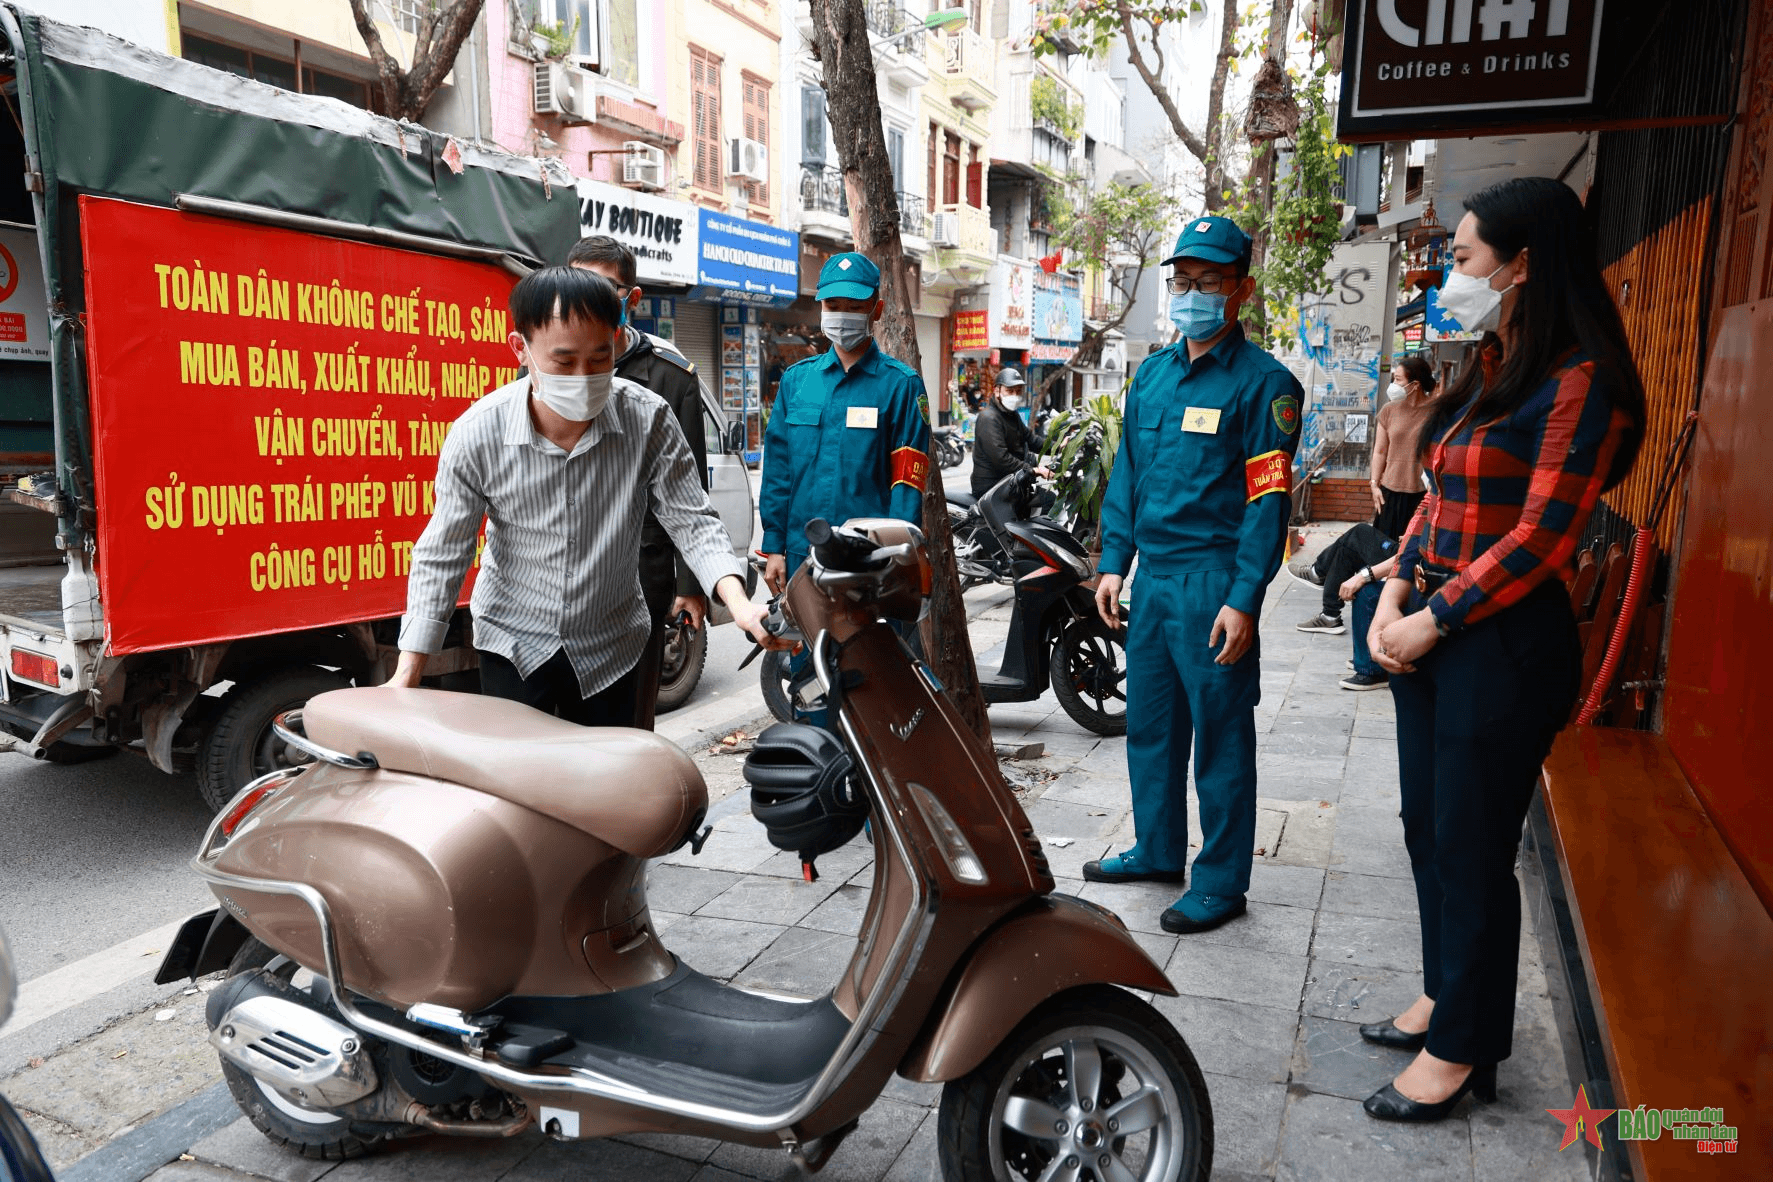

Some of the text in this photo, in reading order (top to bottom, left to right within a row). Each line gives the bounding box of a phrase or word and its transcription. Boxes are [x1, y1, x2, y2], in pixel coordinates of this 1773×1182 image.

[1377, 51, 1571, 81] Coffee & Drinks
[608, 204, 683, 245] BOUTIQUE
[703, 242, 729, 263] HANOI
[729, 247, 744, 266] OLD
[154, 259, 507, 346] TOÀN DÂN KHÔNG CHẾ TẠO, SẢN
[180, 340, 241, 386] MUA
[247, 338, 307, 393] BÁN,
[314, 345, 371, 393] XUẤT
[377, 345, 436, 399] KHẨU,
[441, 357, 492, 405] NHẬP
[255, 407, 305, 466] VẬN
[312, 403, 403, 458] CHUYỂN,
[146, 471, 186, 530] SỬ
[192, 485, 264, 536] DỤNG
[271, 473, 324, 525] TRÁI
[331, 473, 386, 520] PHÉP
[391, 473, 417, 517] VŨ
[250, 530, 414, 592] CÔNG CỤ HỖ TR
